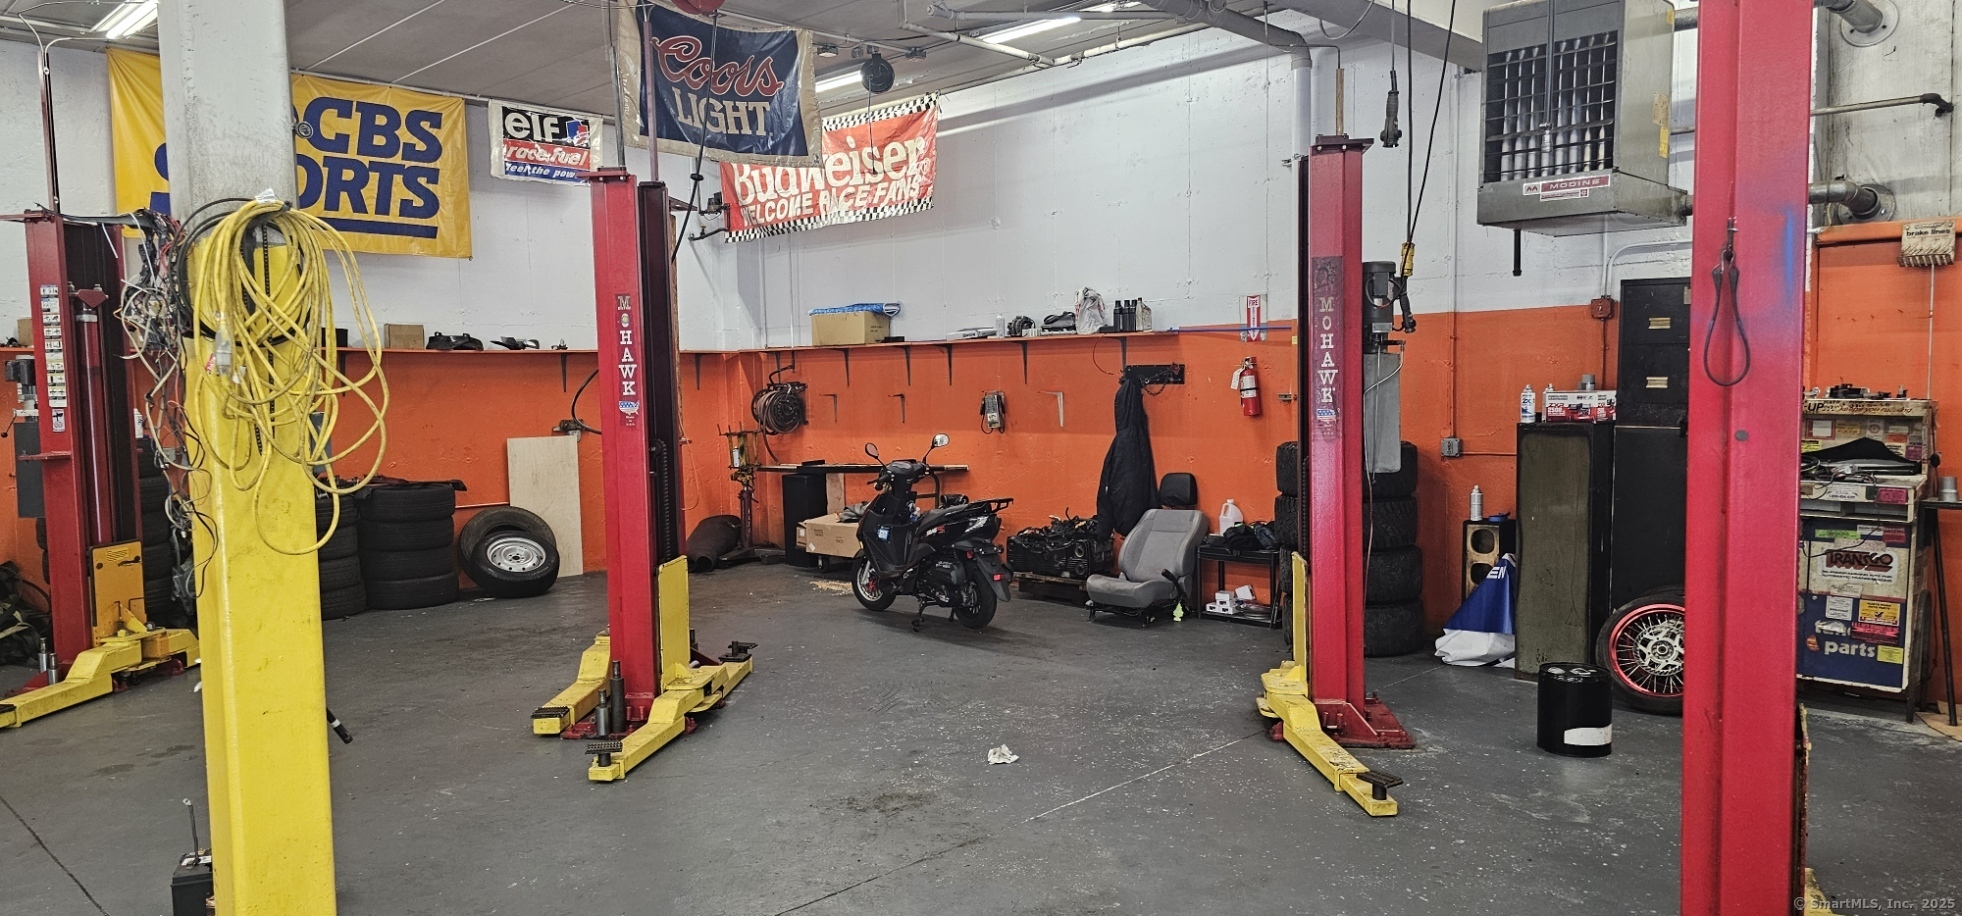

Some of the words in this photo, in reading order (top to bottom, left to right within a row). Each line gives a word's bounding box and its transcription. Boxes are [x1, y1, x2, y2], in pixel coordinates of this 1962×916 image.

[650, 35, 785, 98] Coors
[303, 96, 443, 164] CBS
[504, 112, 560, 143] elf
[671, 86, 771, 137] LIGHT
[531, 164, 551, 177] the
[552, 167, 578, 180] pow
[549, 147, 589, 167] fuel
[732, 135, 926, 207] Budweiser
[296, 153, 441, 220] ORTS
[741, 191, 814, 228] WELCOME
[817, 184, 869, 216] RACE
[872, 176, 920, 207] FANS
[1549, 178, 1600, 191] MODINE
[617, 295, 638, 397] MOHAWK
[1316, 296, 1339, 403] MOHAWK
[1825, 549, 1894, 571] TRANSGO
[1823, 640, 1876, 658] parts
